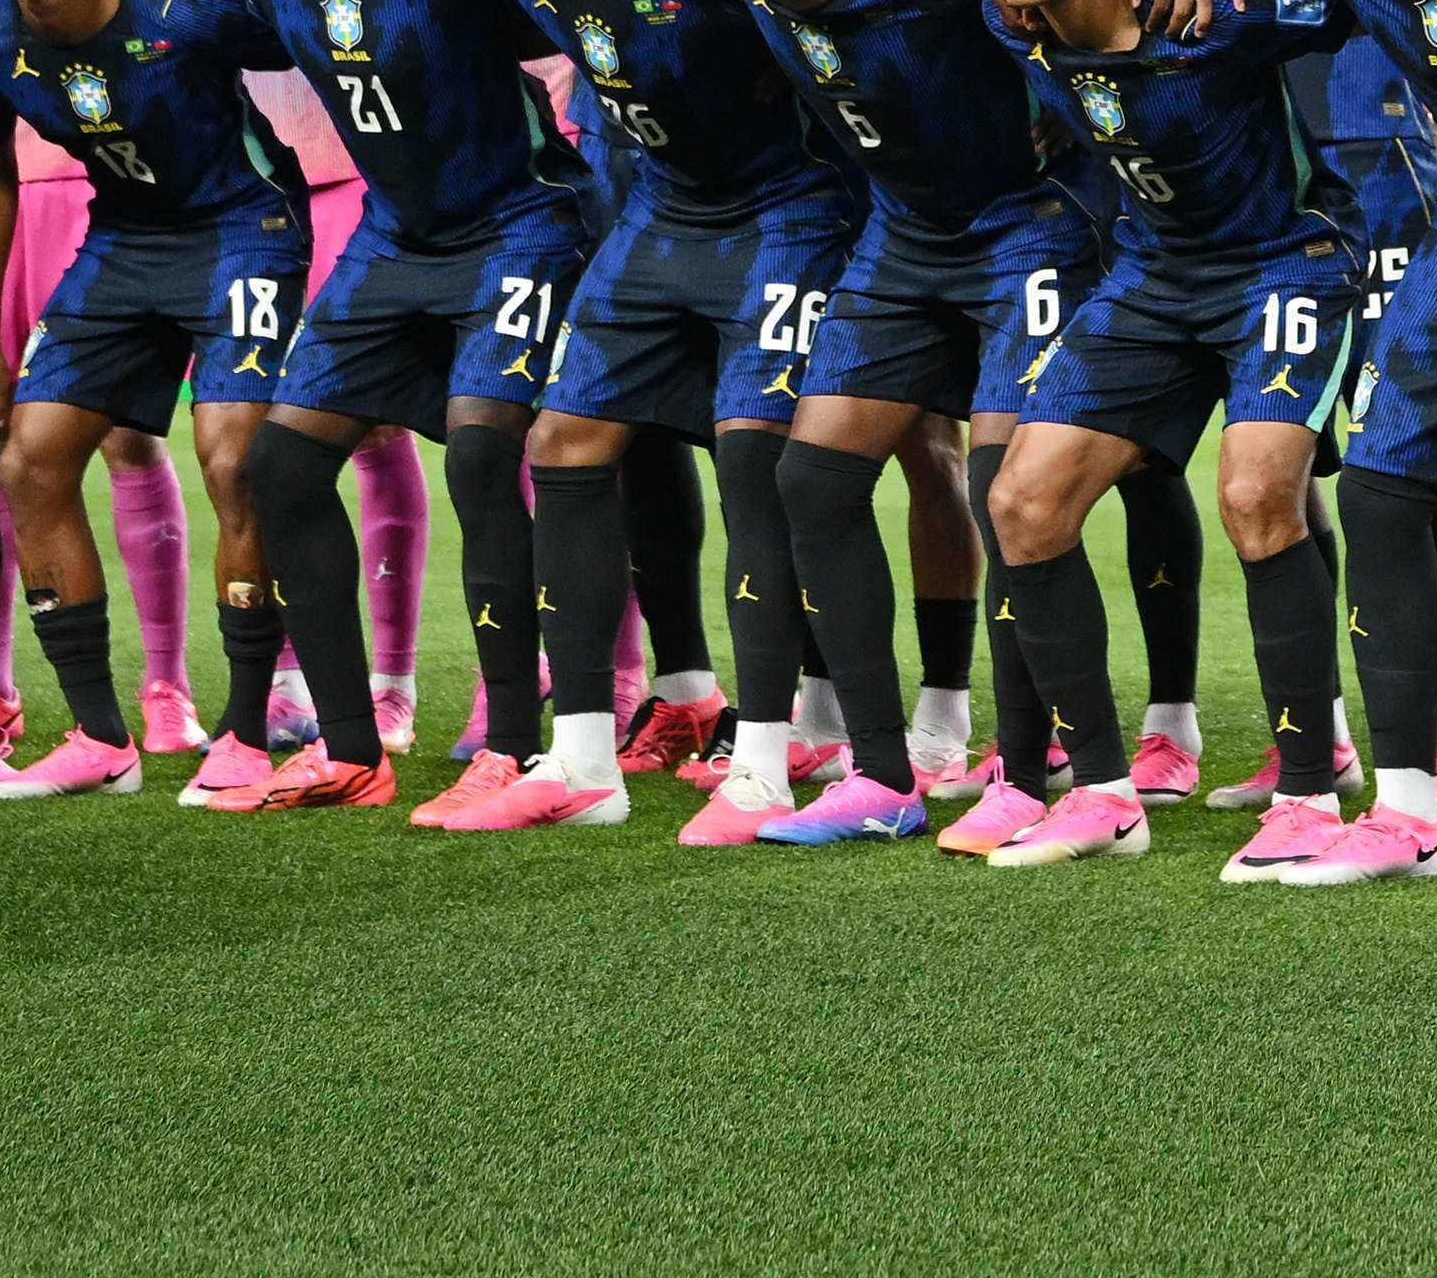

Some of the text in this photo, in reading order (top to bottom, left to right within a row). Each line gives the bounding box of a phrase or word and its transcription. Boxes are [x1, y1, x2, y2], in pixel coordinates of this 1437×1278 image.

[331, 49, 371, 62] BRASIL
[339, 75, 404, 134] 21
[592, 74, 634, 89] BRASIL
[80, 122, 124, 134] BRASIL
[836, 100, 882, 149] 6
[95, 140, 156, 186] 18
[1110, 154, 1175, 203] 16
[227, 277, 279, 340] 18
[494, 276, 553, 344] 21
[1025, 268, 1060, 336] 6
[1262, 292, 1318, 355] 16
